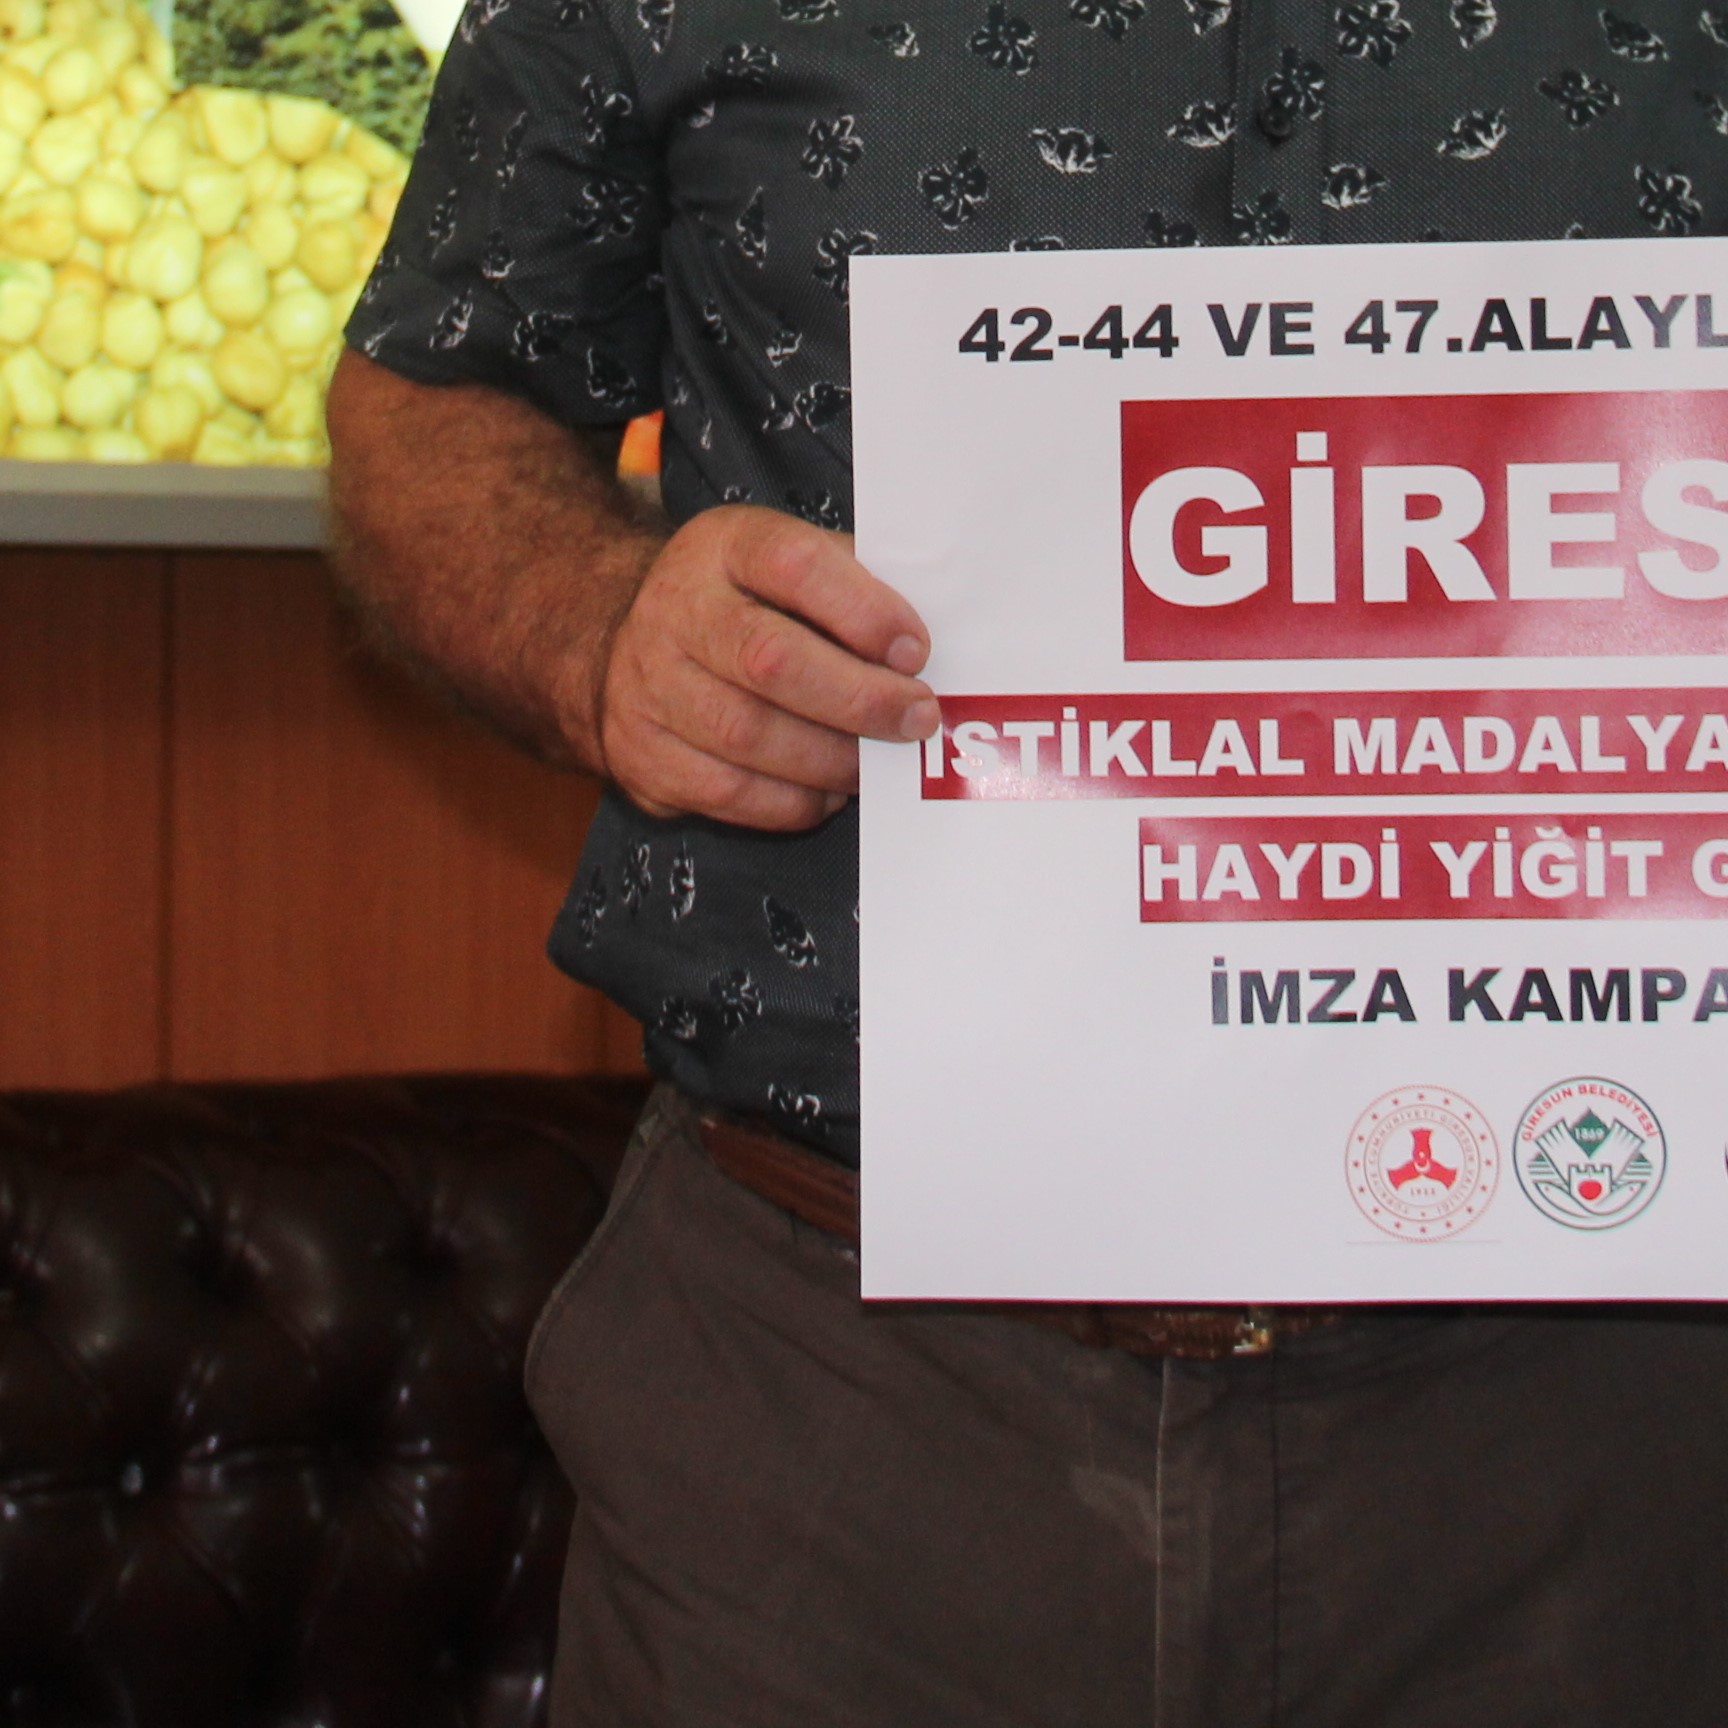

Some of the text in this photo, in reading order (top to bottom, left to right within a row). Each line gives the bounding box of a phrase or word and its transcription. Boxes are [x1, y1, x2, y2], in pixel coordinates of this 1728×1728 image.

[958, 304, 1181, 363] 42-44
[1206, 301, 1317, 358] VE
[1143, 828, 1400, 901] HAYDİ
[1430, 826, 1664, 900] YİĞİT
[1211, 957, 1418, 1026] İMZA
[1521, 1083, 1660, 1142] GİRESUN BELEDİYESİ
